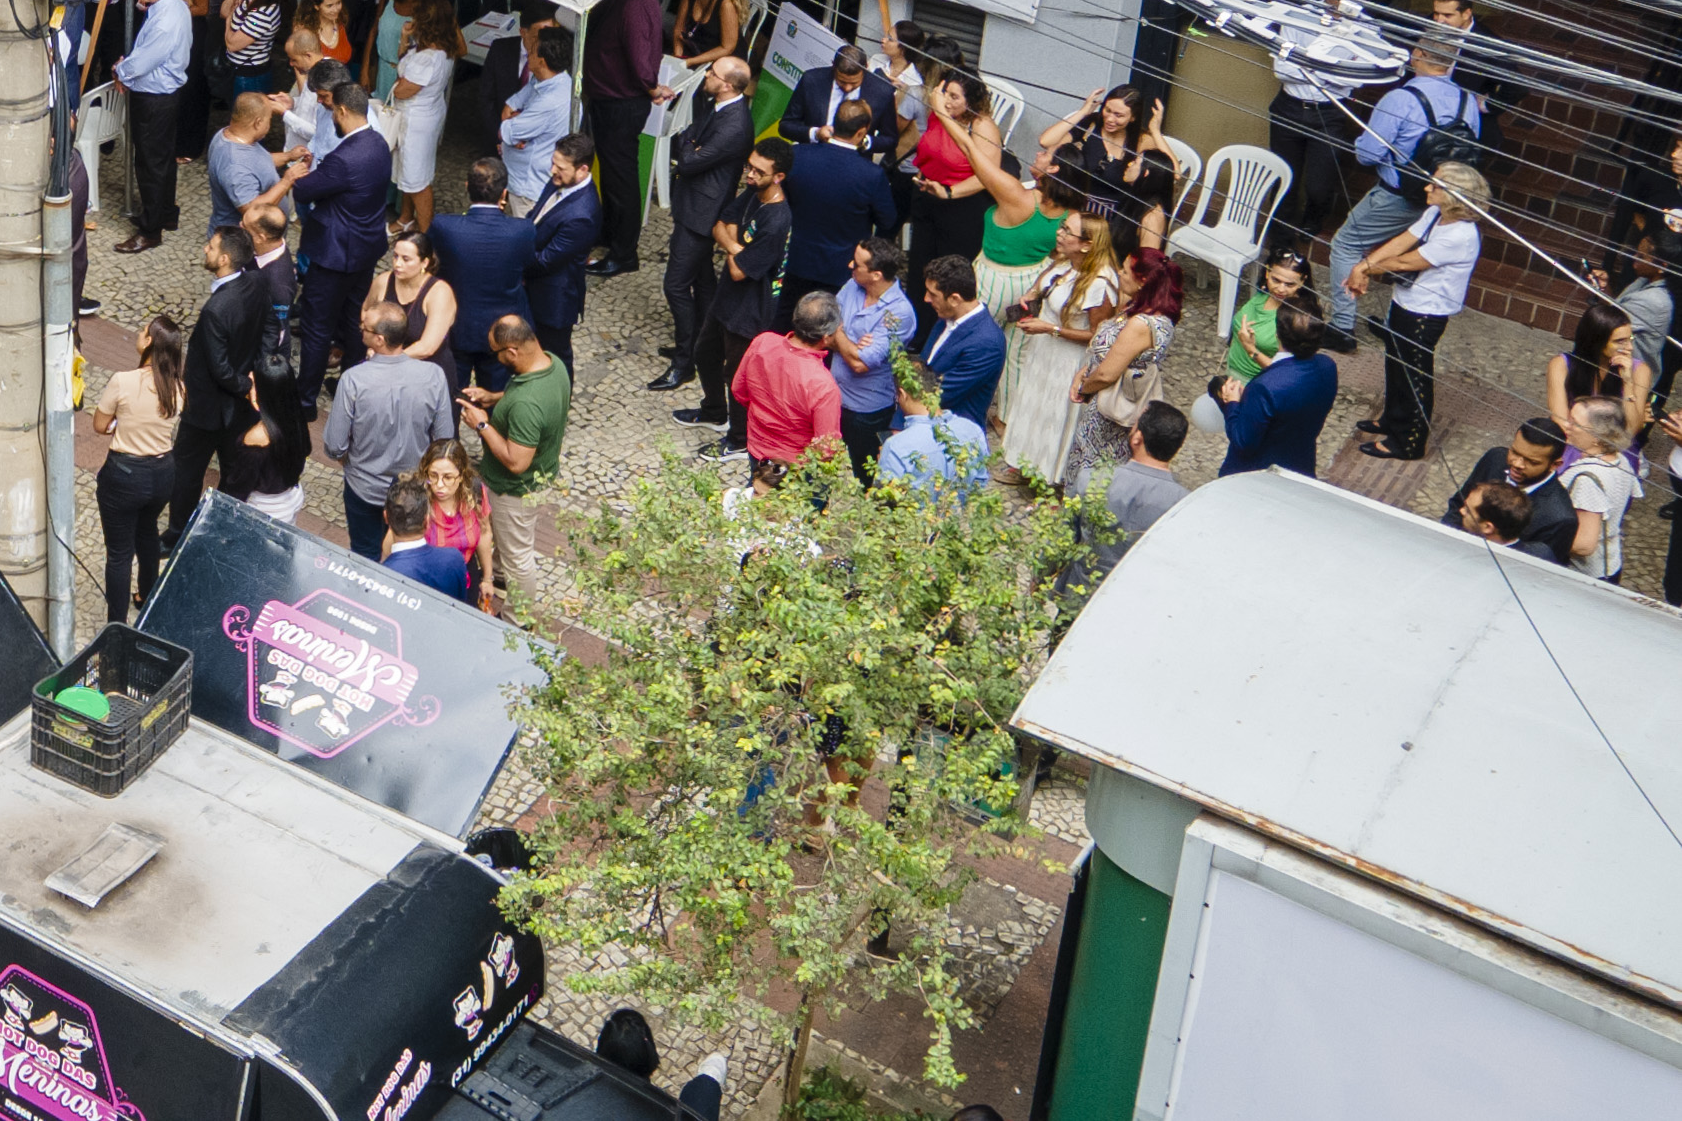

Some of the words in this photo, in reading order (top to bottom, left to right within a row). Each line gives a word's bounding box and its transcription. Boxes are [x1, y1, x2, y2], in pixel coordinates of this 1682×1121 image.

[328, 561, 395, 598] 99434-0171
[397, 592, 422, 611] (31)
[267, 649, 304, 675] DAS
[270, 620, 403, 692] Meninas
[302, 665, 340, 694] DOG
[336, 682, 375, 712] HOT
[452, 1056, 471, 1088] (31)
[473, 994, 529, 1061] 99434-0171
[25, 1036, 60, 1069] DOG
[62, 1057, 97, 1090] DAS
[367, 1093, 385, 1121] HOT
